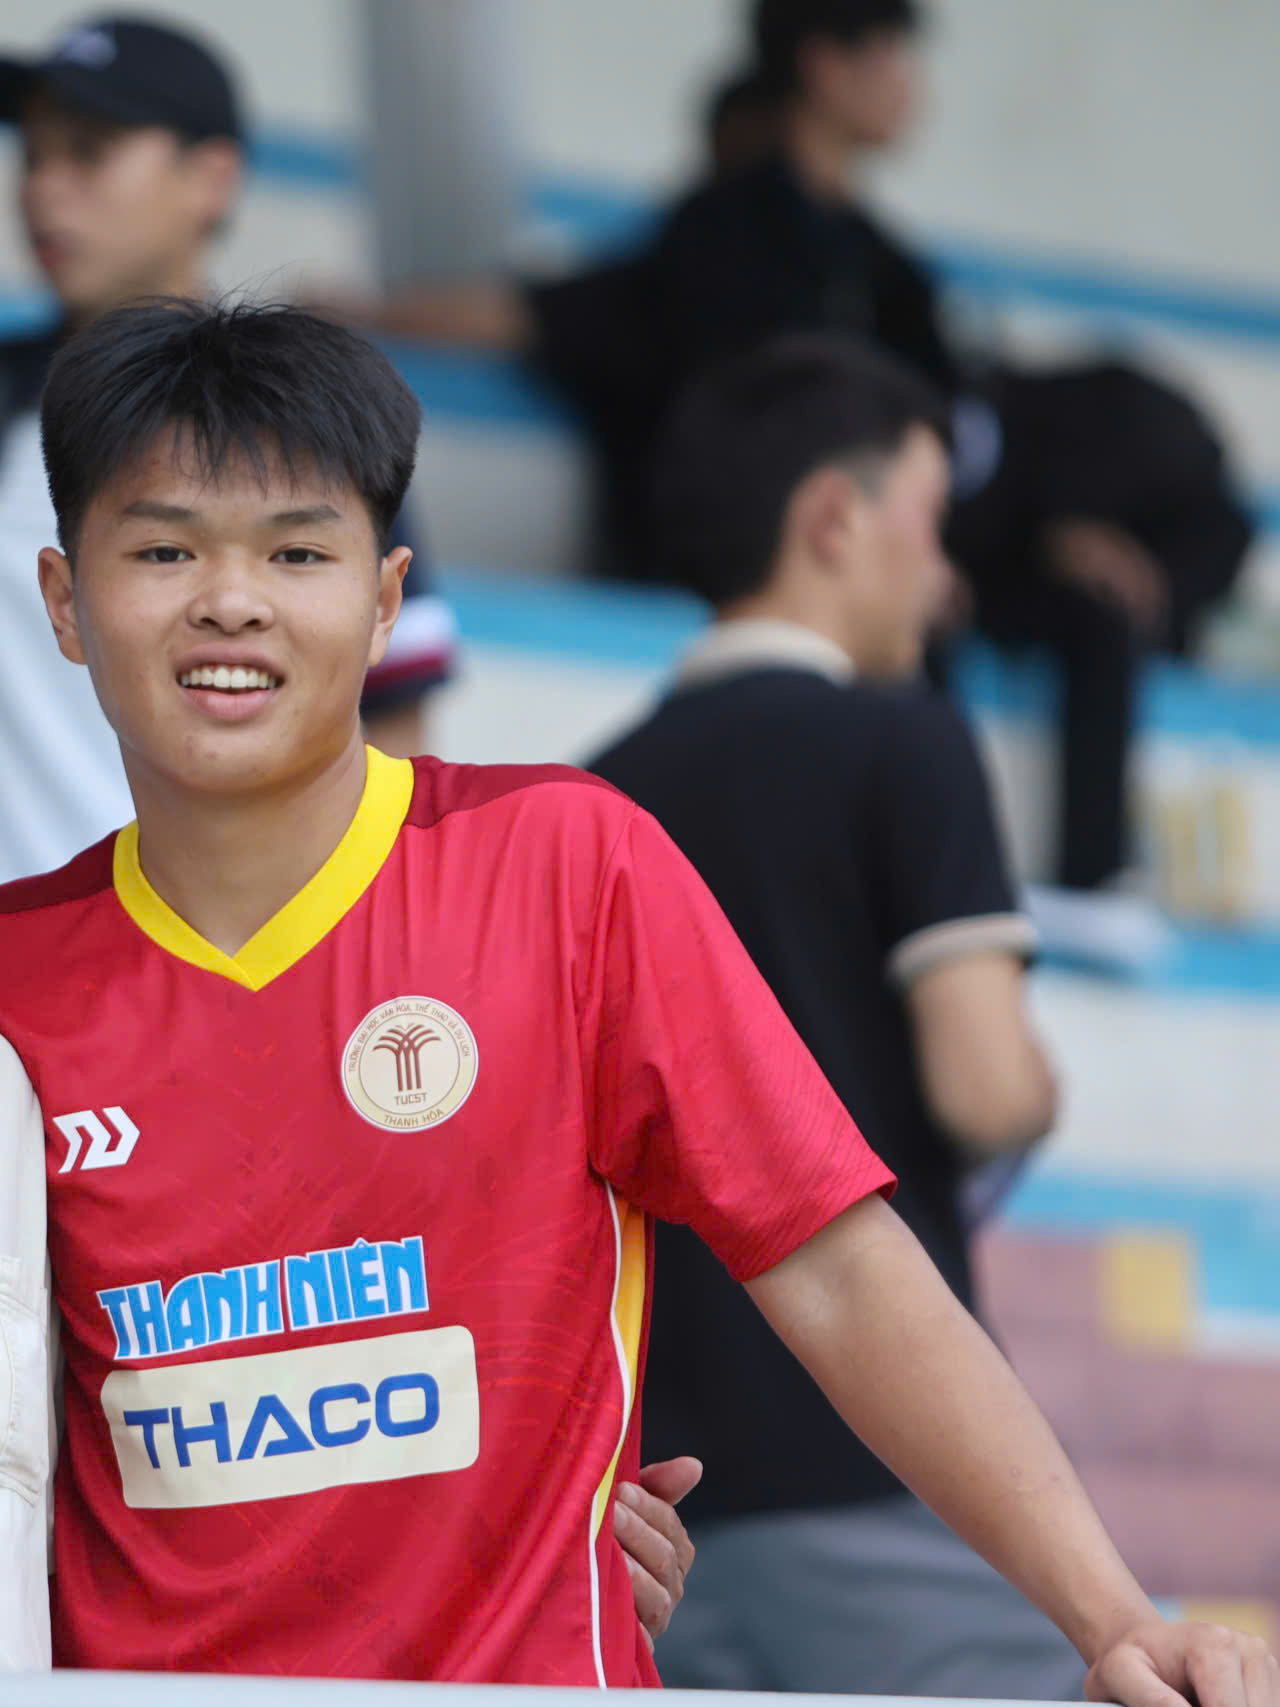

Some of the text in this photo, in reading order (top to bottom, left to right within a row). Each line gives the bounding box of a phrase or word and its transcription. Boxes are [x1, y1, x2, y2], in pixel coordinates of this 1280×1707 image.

[384, 1114, 419, 1127] THANH
[96, 1235, 429, 1360] THANH NIÊN
[122, 1372, 440, 1470] THACO
